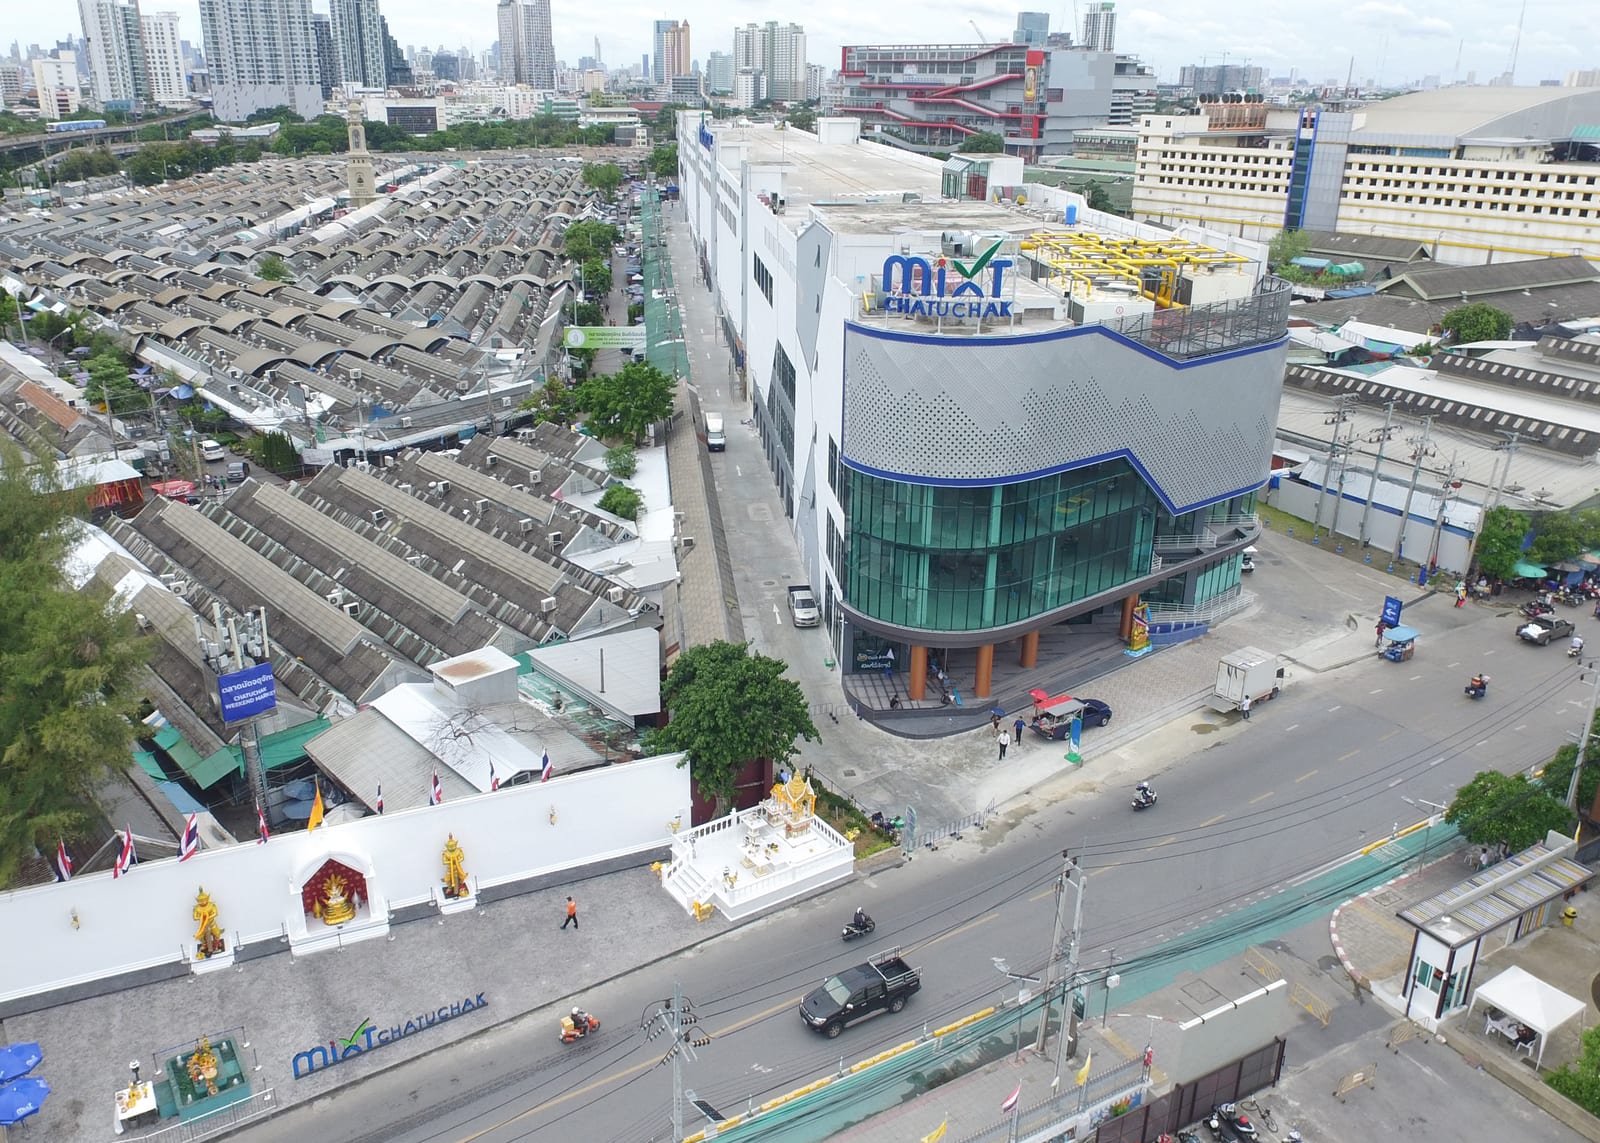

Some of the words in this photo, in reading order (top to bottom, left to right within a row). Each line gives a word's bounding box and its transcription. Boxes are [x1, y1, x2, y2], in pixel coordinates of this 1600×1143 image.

[884, 297, 1013, 318] CHATUCHAK
[233, 687, 267, 701] CHATUCHAK
[225, 698, 254, 710] WEEKEND
[377, 992, 488, 1044] CHATUCHAK
